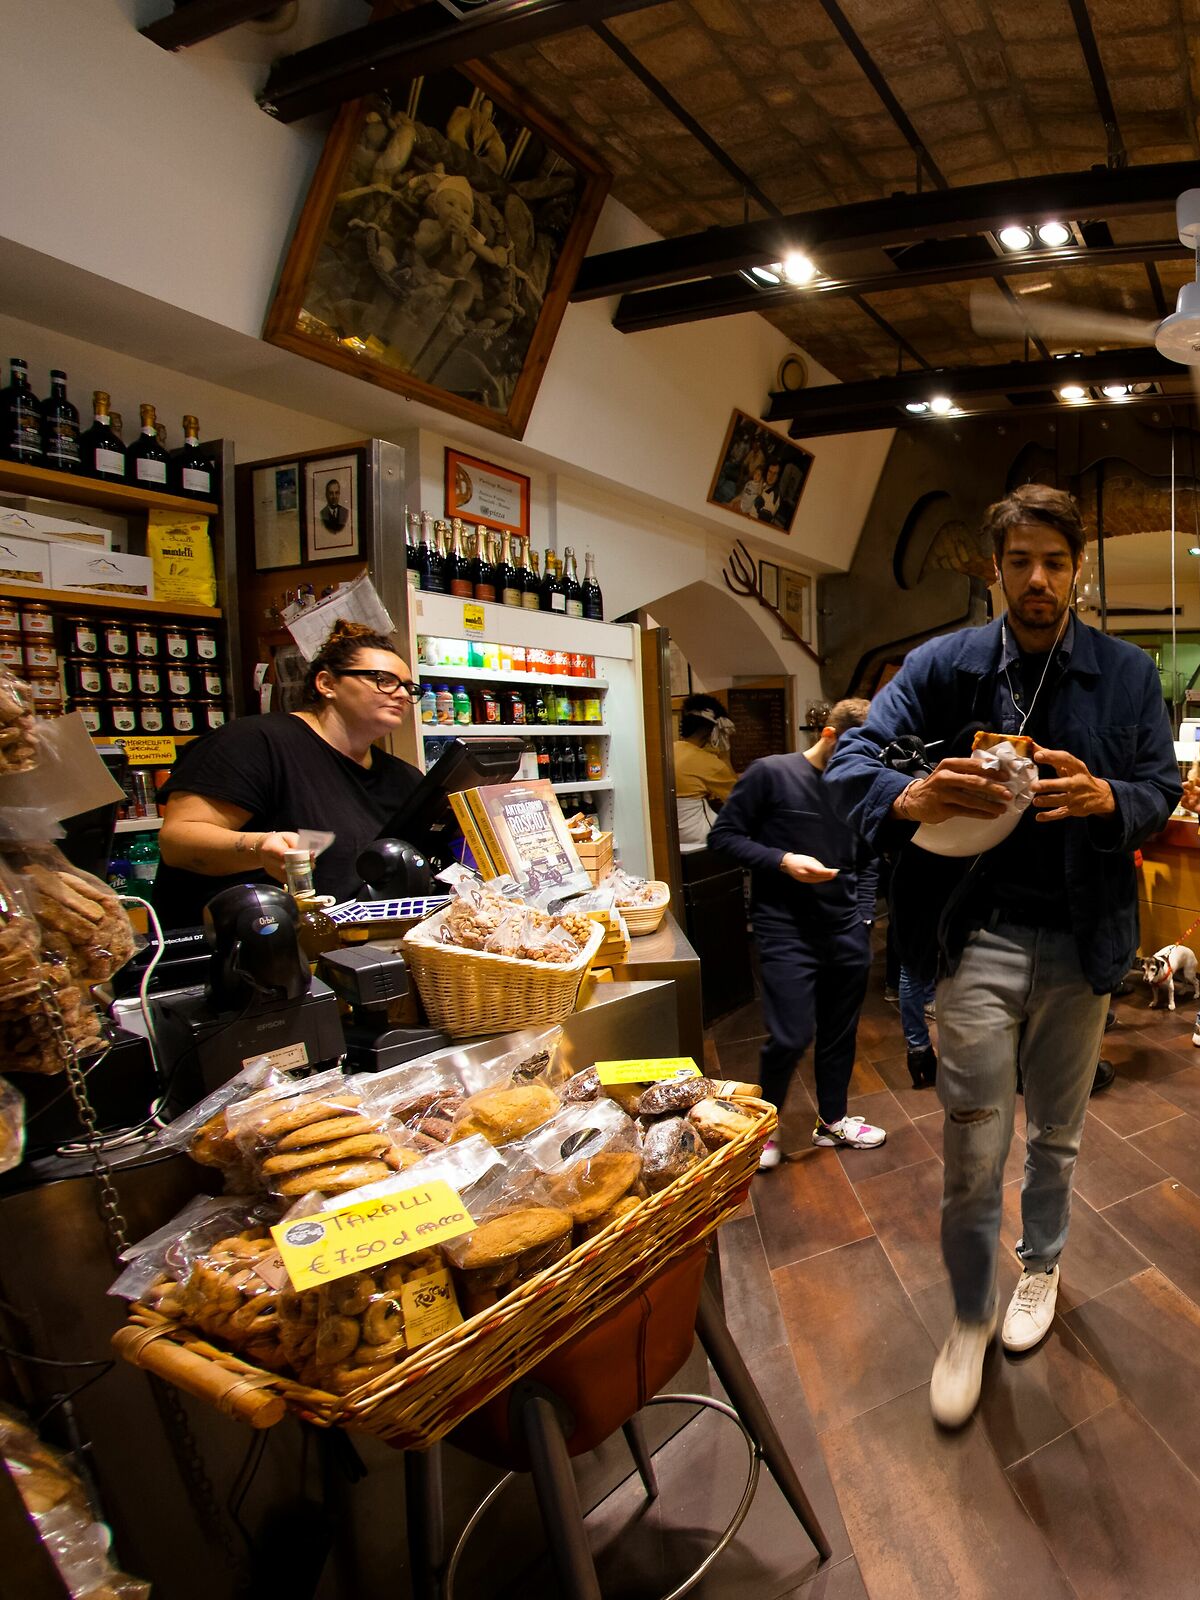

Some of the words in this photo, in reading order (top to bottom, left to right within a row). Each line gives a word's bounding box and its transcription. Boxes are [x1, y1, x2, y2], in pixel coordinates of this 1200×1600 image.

[256, 1020, 286, 1032] EPSON
[320, 1193, 432, 1231] TARALLI
[309, 1256, 331, 1275] €
